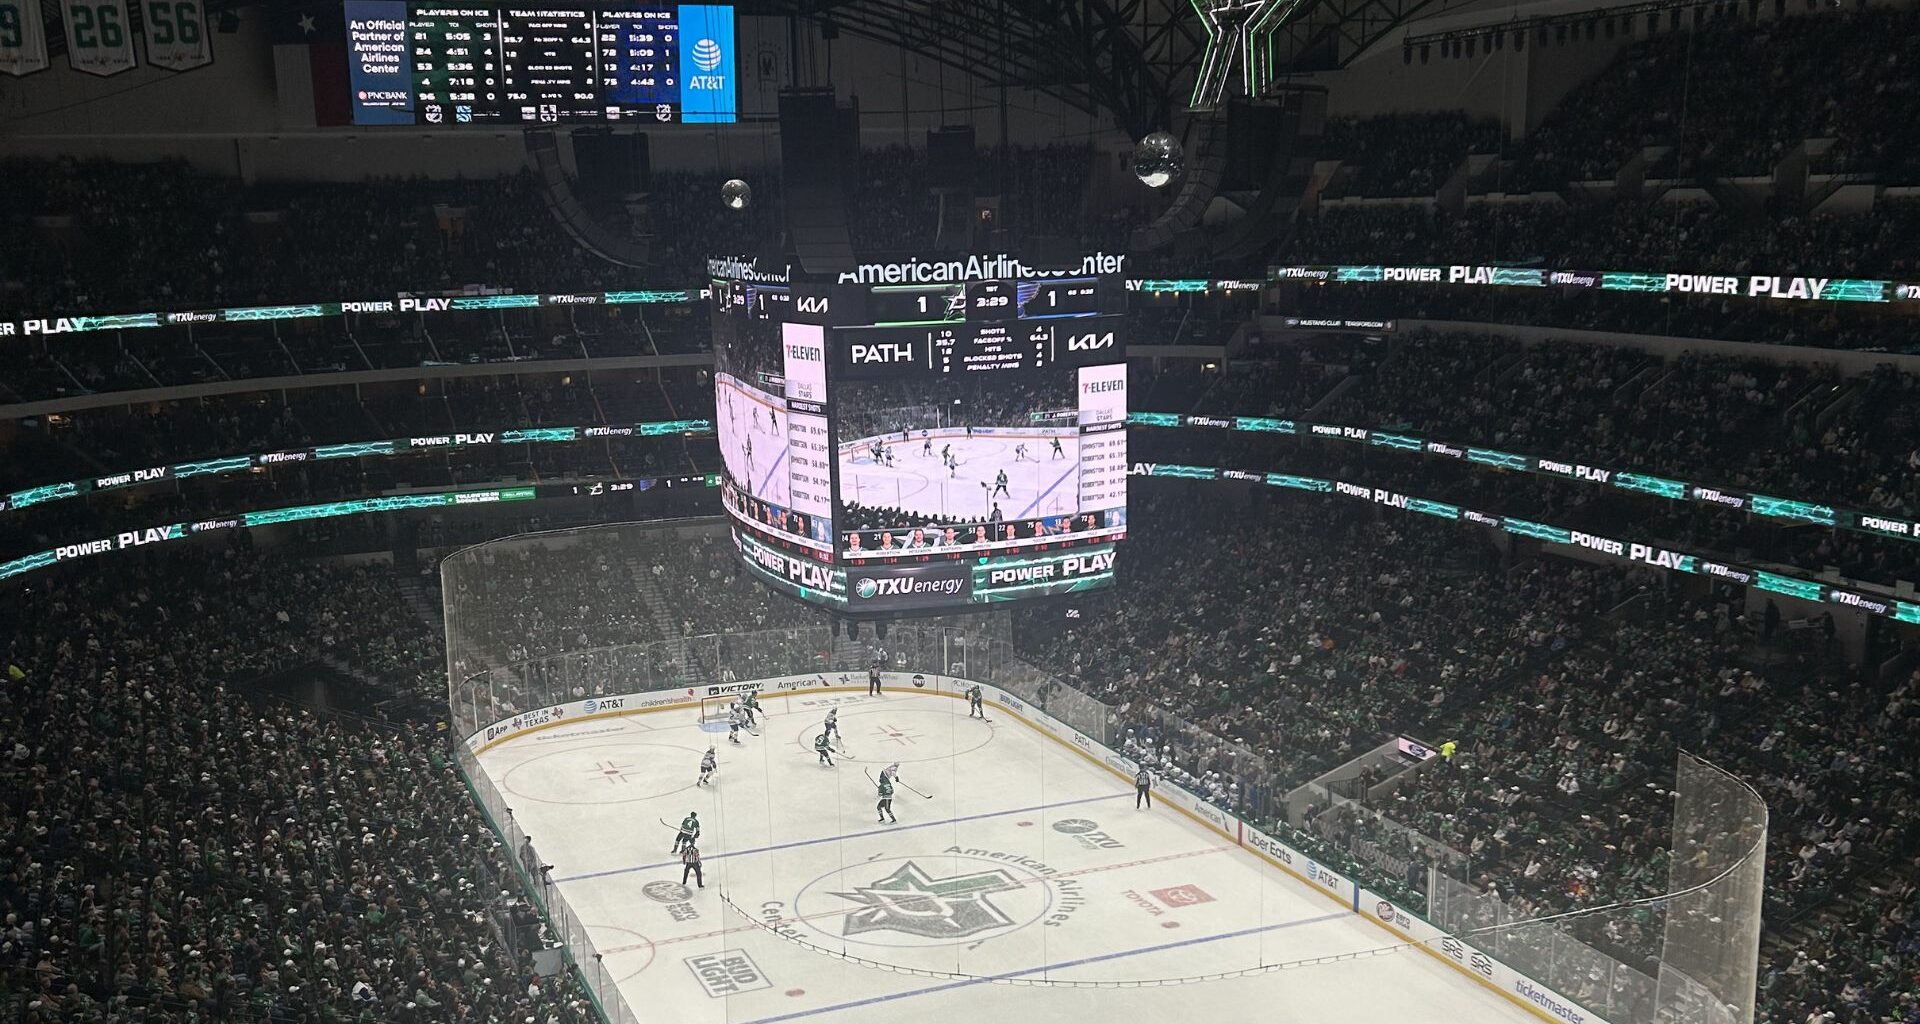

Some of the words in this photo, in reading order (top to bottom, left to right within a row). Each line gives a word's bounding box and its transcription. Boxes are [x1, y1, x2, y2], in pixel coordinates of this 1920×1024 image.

[71, 5, 123, 48] 26
[149, 2, 200, 44] 56
[350, 20, 365, 30] An
[366, 20, 405, 30] Official
[352, 31, 391, 41] Partner
[393, 31, 404, 41] of
[415, 32, 427, 40] 21
[445, 33, 471, 41] 5:05
[664, 34, 673, 42] 0
[354, 42, 405, 52] American
[665, 49, 670, 57] 1
[361, 53, 400, 62] Airlines
[363, 64, 399, 73] Center
[604, 63, 617, 71] 13
[630, 63, 654, 71] 4:17
[665, 63, 670, 71] 1
[485, 78, 494, 86] 0
[603, 78, 618, 86] 75
[666, 78, 674, 86] 0
[690, 75, 725, 90] AT&T
[1383, 267, 1441, 281] POWER
[1449, 265, 1498, 285] PLAY
[1665, 273, 1738, 295] POWER
[1750, 275, 1828, 300] PLAY
[341, 302, 393, 313] POWER
[400, 297, 451, 312] PLAY
[917, 296, 927, 313] 1
[976, 296, 1009, 307] 3:29
[1047, 290, 1056, 307] 1
[24, 316, 84, 335] PLAY
[940, 330, 952, 338] 10
[980, 327, 1006, 335] SHOTS
[973, 336, 1005, 345] FACEOFF
[851, 342, 912, 364] PATH
[967, 362, 1000, 371] PENALTY
[410, 436, 450, 447] POWER
[455, 433, 494, 445] PLAY
[1312, 425, 1341, 435] POWER
[1344, 427, 1367, 439] PLAY
[97, 473, 131, 487] POWER
[134, 467, 166, 482] PLAY
[1538, 459, 1573, 474] POWER
[1575, 465, 1610, 483] PLAY
[1336, 481, 1370, 500] POWER
[1374, 489, 1408, 509] PLAY
[1862, 516, 1908, 533] POWER
[55, 538, 112, 560] POWER
[117, 526, 172, 549] PLAY
[1571, 530, 1623, 556] POWER
[1630, 543, 1685, 570] PLAY
[753, 545, 785, 574] POWER
[789, 557, 834, 591] PLAY
[991, 565, 1054, 584] POWER
[1062, 552, 1117, 577] PLAY
[778, 679, 817, 689] American
[599, 698, 625, 711] AT&T
[523, 712, 540, 720] BEST
[524, 715, 549, 728] TEXAS
[1074, 733, 1090, 749] PATH
[1247, 829, 1269, 851] Uber
[1269, 841, 1292, 864] Eats
[943, 845, 1058, 875] American
[1043, 879, 1086, 928] Airlines
[1318, 870, 1338, 890] AT&T
[1121, 889, 1165, 917] TOYOTA
[761, 901, 809, 941] Center
[1442, 939, 1463, 960] SRS
[720, 956, 758, 984] BUD
[1471, 955, 1492, 976] SRS
[692, 956, 740, 994] LIGHT
[1515, 979, 1585, 1024] ticketmaster
